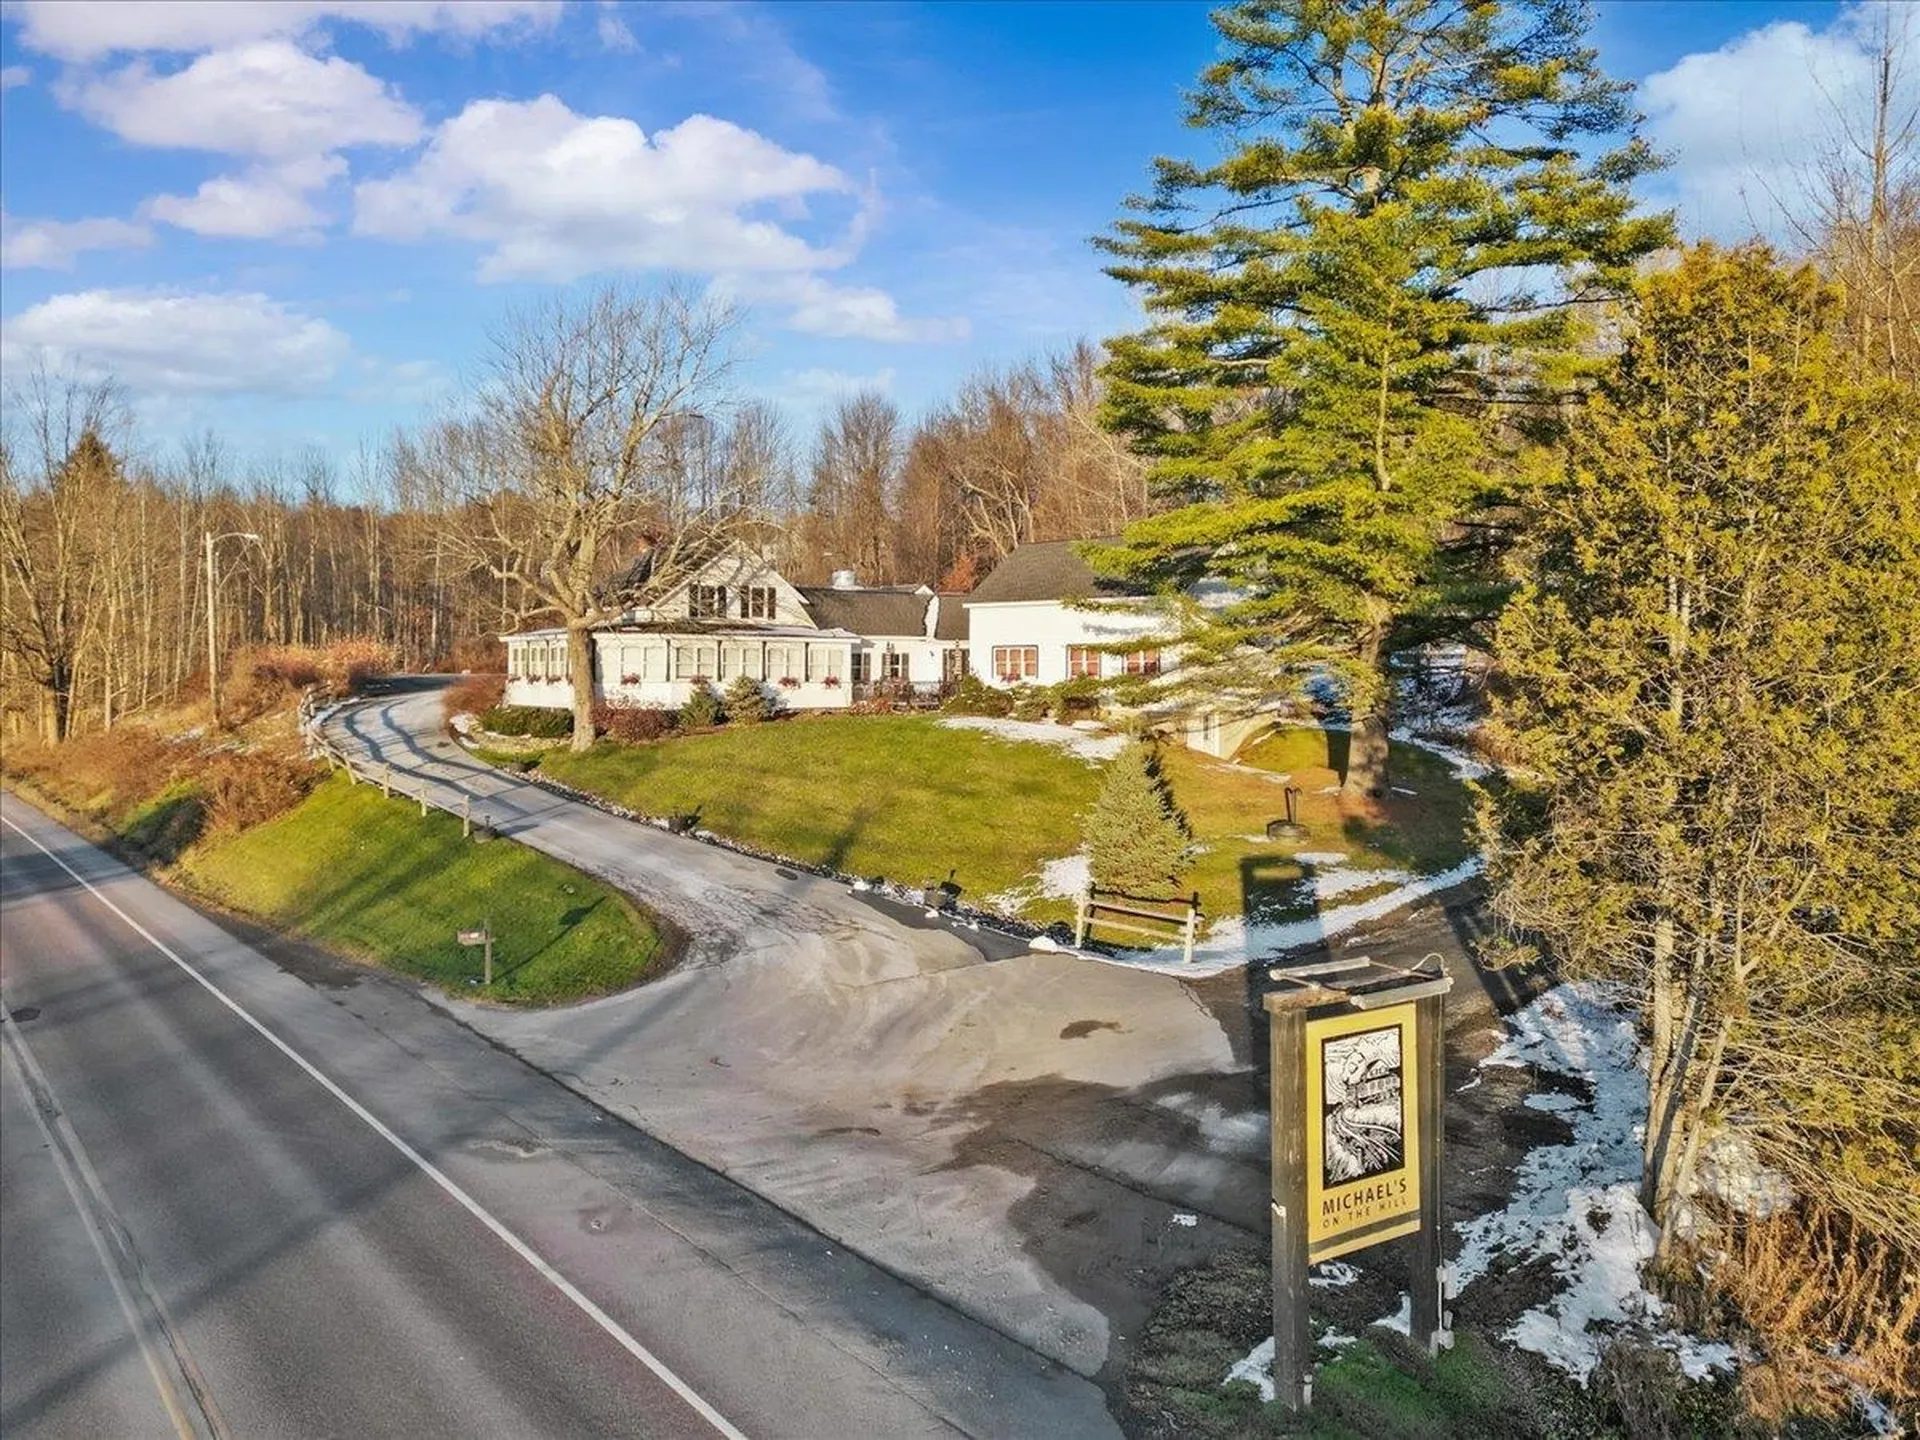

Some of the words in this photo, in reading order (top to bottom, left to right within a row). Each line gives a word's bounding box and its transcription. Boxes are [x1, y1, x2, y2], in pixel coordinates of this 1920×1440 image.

[1322, 1178, 1407, 1216] MICHAEL'S
[1323, 1217, 1339, 1228] ON
[1348, 1206, 1371, 1220] THE
[1379, 1197, 1407, 1211] HILL
